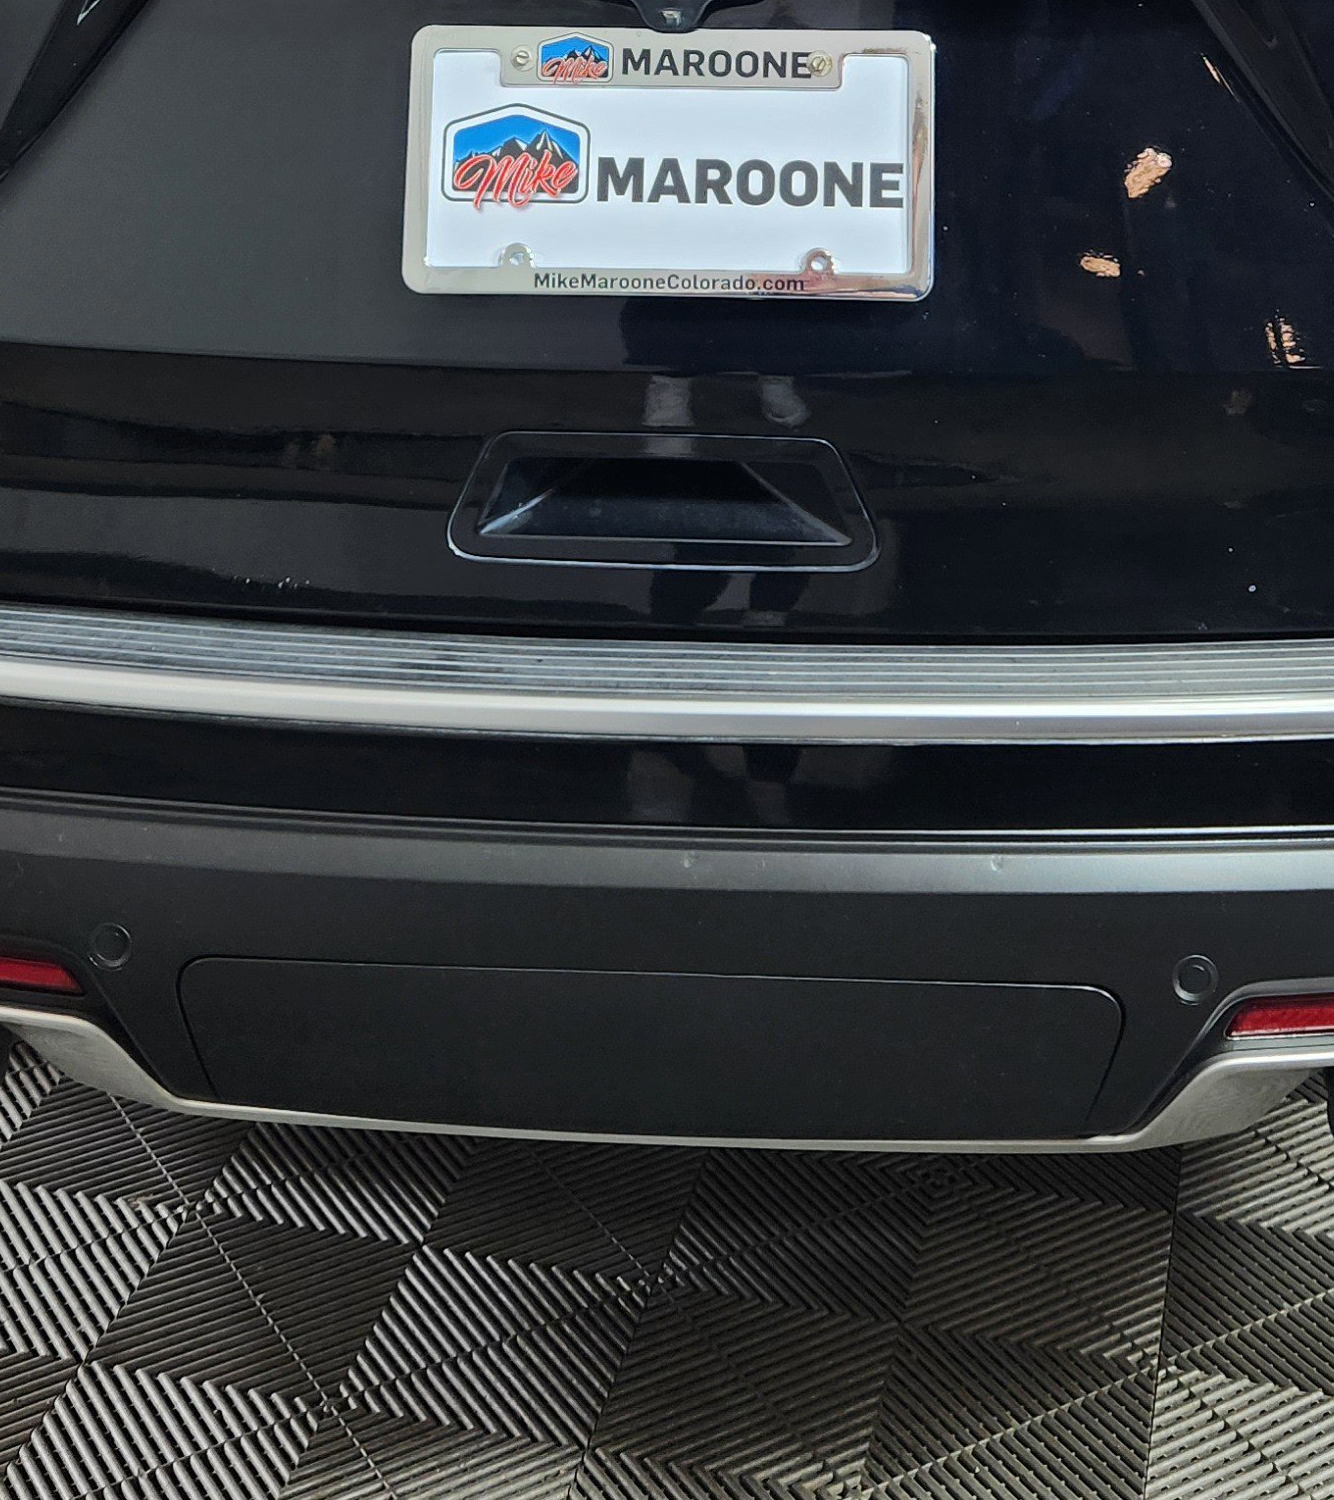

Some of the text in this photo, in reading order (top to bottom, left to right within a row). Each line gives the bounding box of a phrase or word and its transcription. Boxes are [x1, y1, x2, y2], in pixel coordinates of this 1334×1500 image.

[540, 48, 812, 84] Mike MAROONE
[453, 149, 905, 210] Mike MAROONE
[534, 272, 805, 292] MikeMarooneColorado.com
